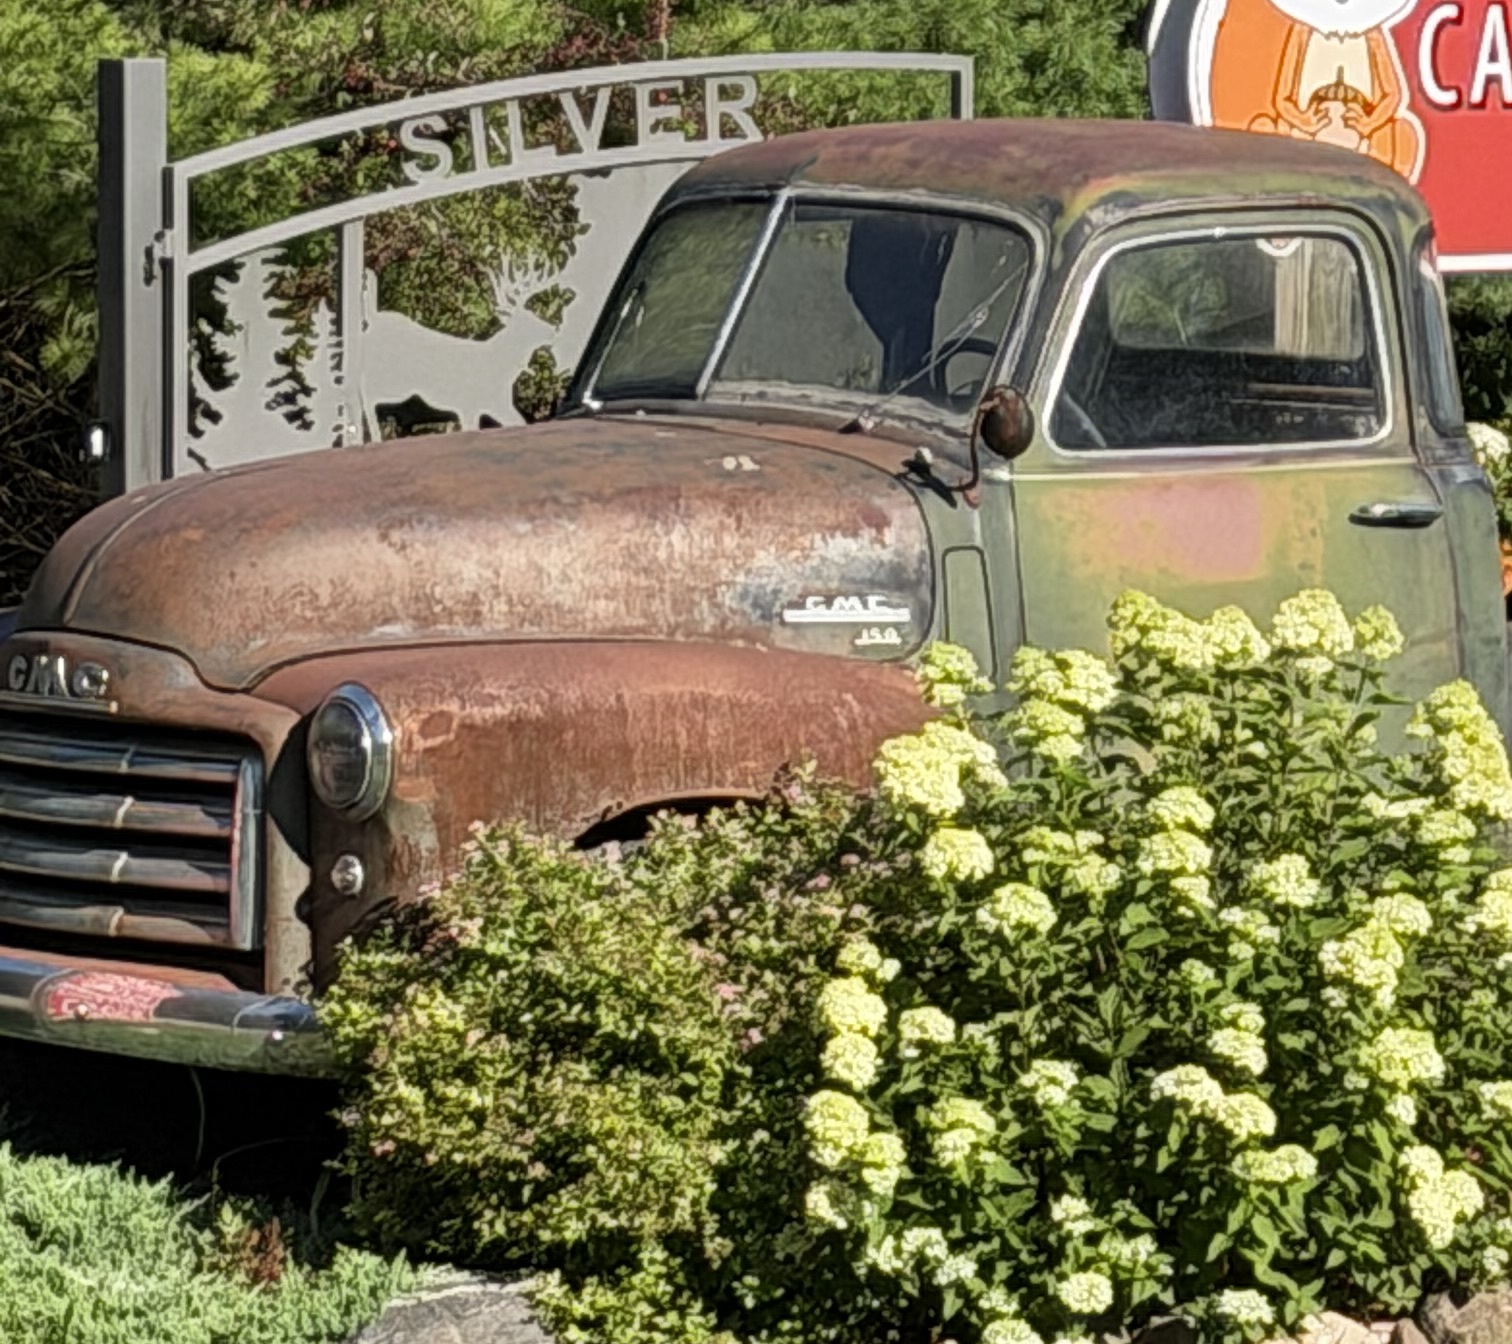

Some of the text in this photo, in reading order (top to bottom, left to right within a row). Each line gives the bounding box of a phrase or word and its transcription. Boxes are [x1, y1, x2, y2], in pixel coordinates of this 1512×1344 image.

[401, 74, 764, 183] SILVER
[804, 595, 889, 612] GMC
[9, 655, 109, 698] GMC
